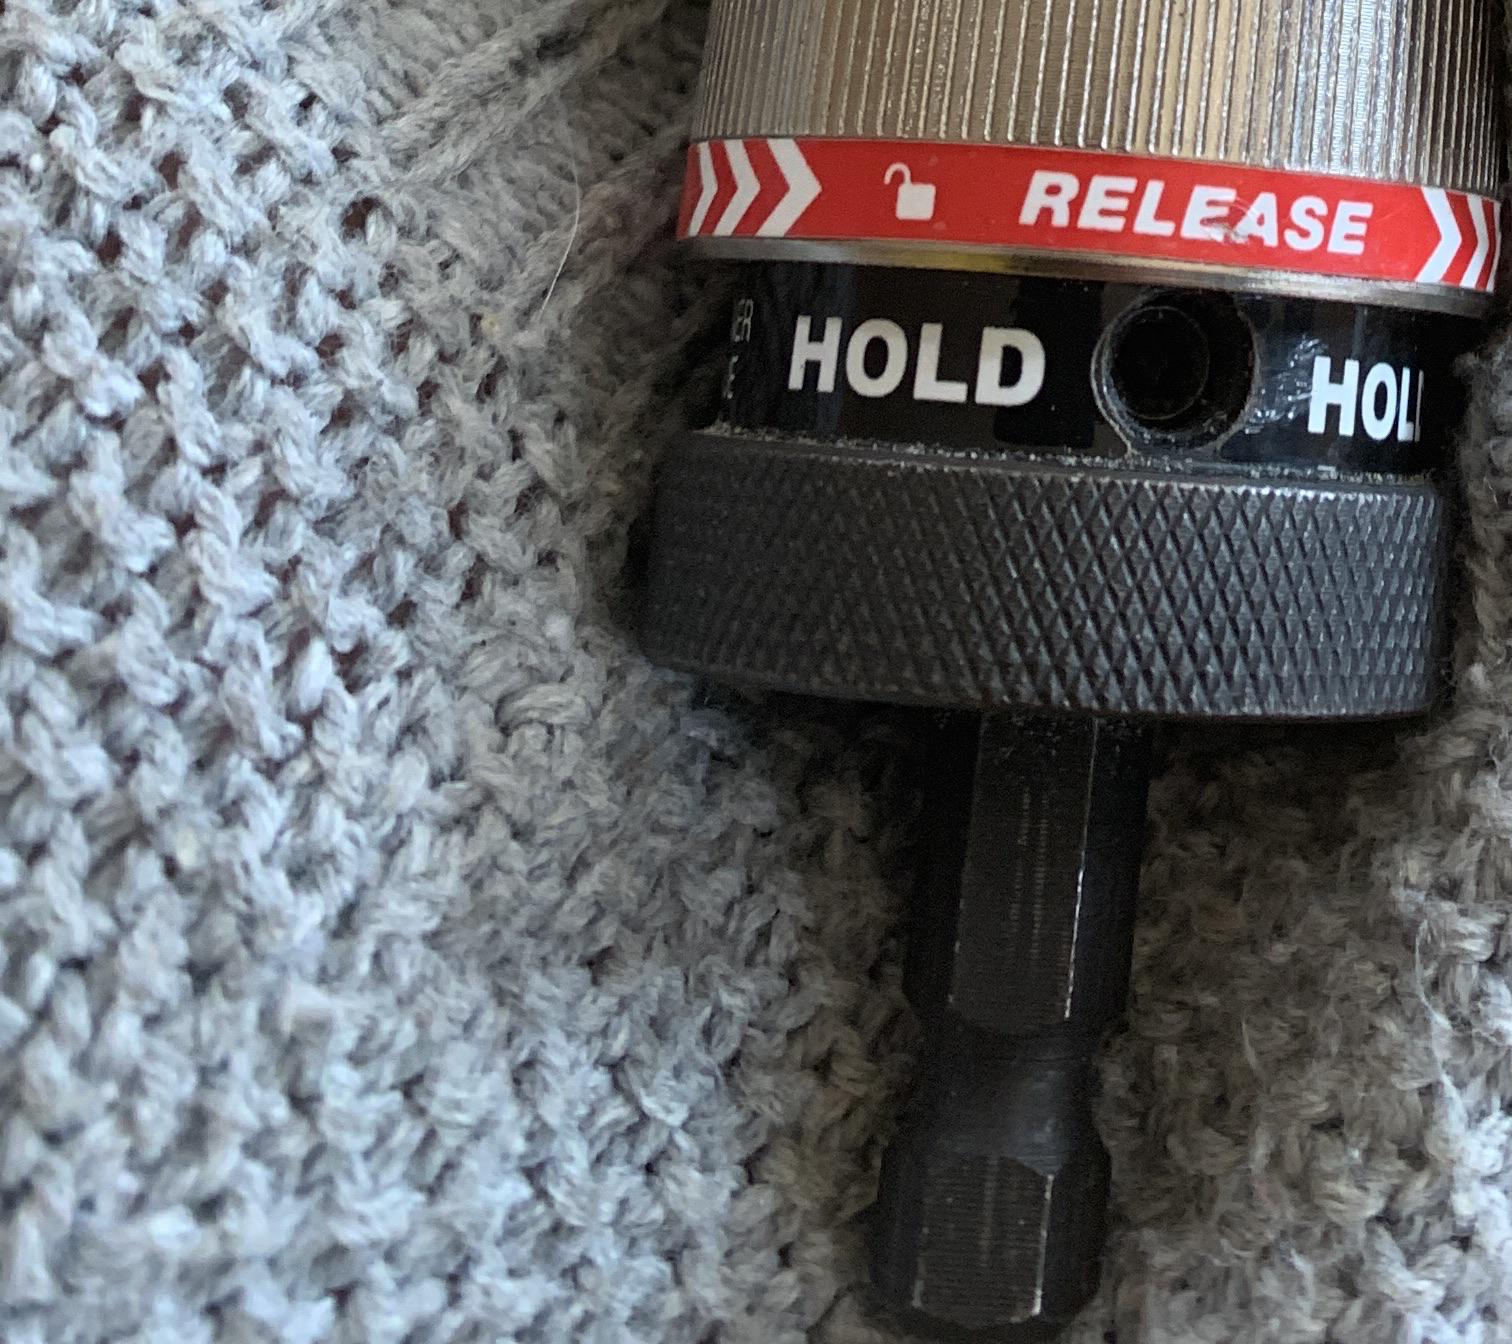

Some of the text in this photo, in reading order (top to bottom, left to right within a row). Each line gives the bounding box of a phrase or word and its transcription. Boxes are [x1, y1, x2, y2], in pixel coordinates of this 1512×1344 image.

[1018, 169, 1374, 257] RELEASE
[787, 316, 1046, 407] HOLD
[1308, 355, 1423, 442] HOL
